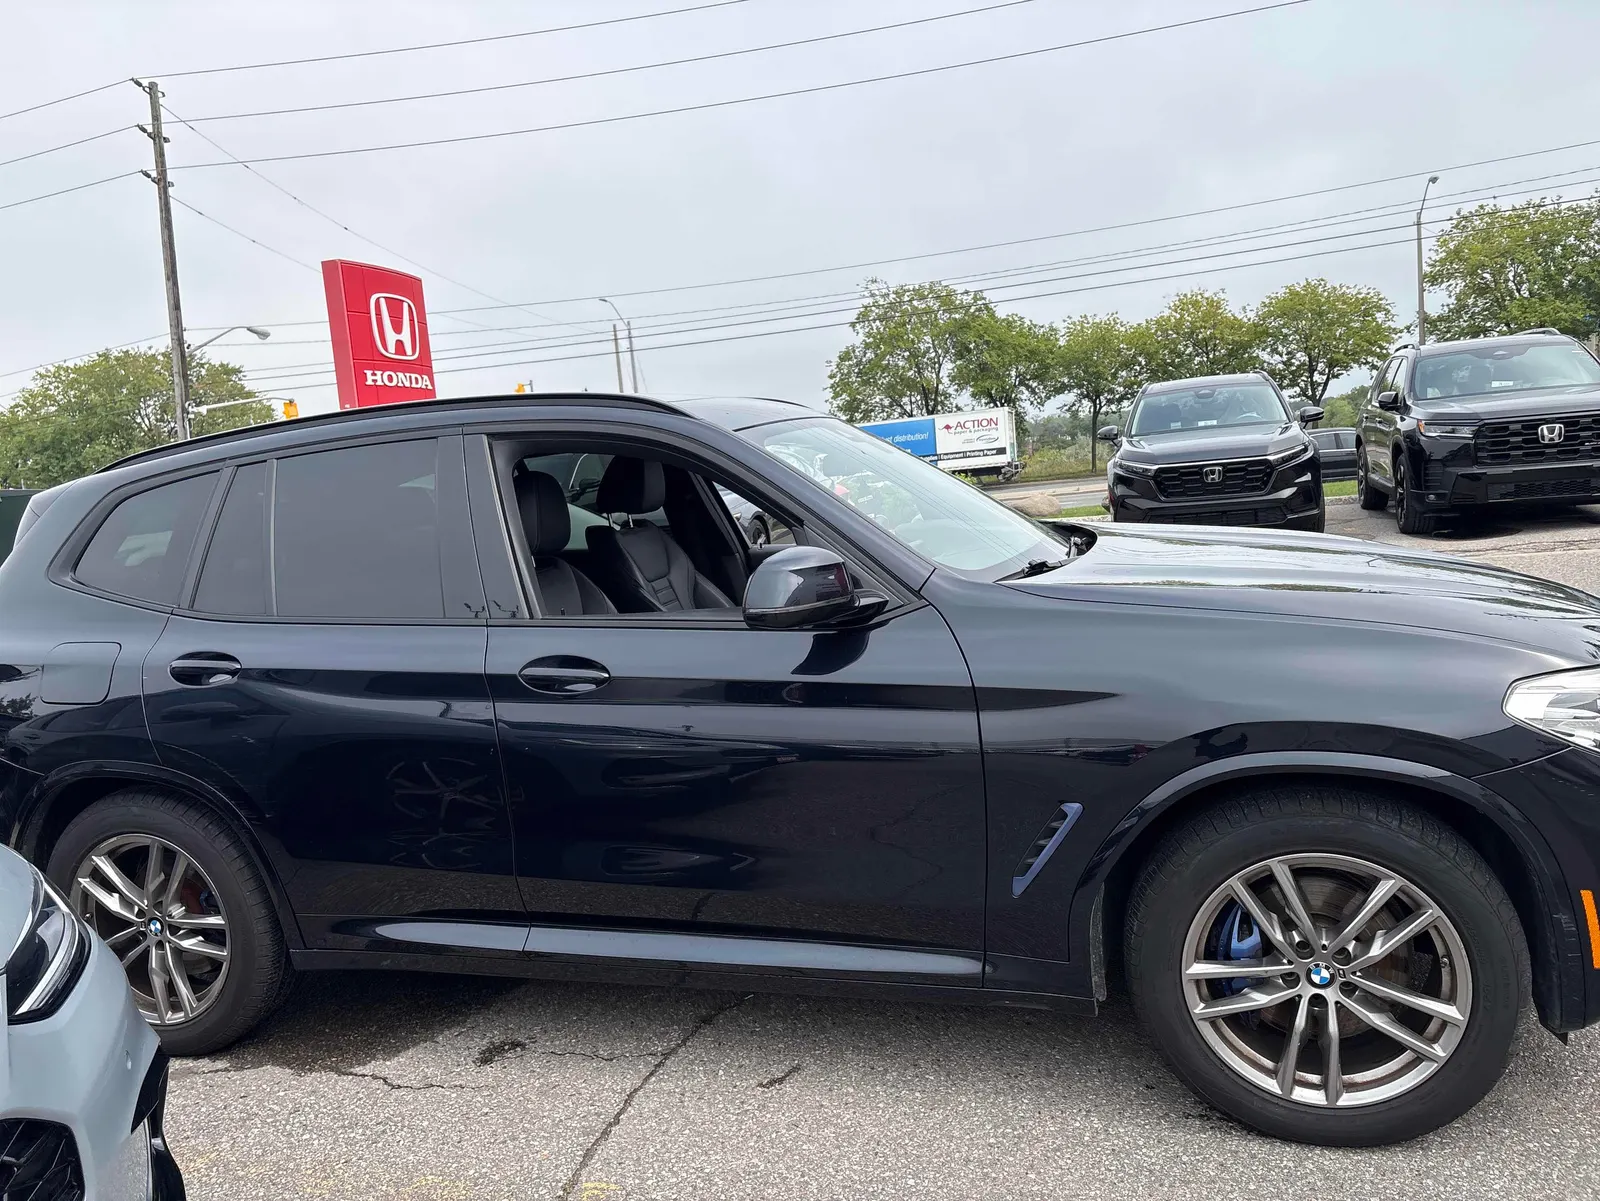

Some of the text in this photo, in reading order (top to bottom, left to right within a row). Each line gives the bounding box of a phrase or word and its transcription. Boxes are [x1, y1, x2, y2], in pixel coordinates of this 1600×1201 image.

[364, 369, 433, 390] HONDA
[954, 417, 998, 430] ACTION
[894, 432, 929, 442] distribution!
[941, 452, 964, 460] Equipment
[966, 450, 984, 458] Printing
[984, 448, 997, 456] Paper
[1310, 962, 1335, 974] BMW
